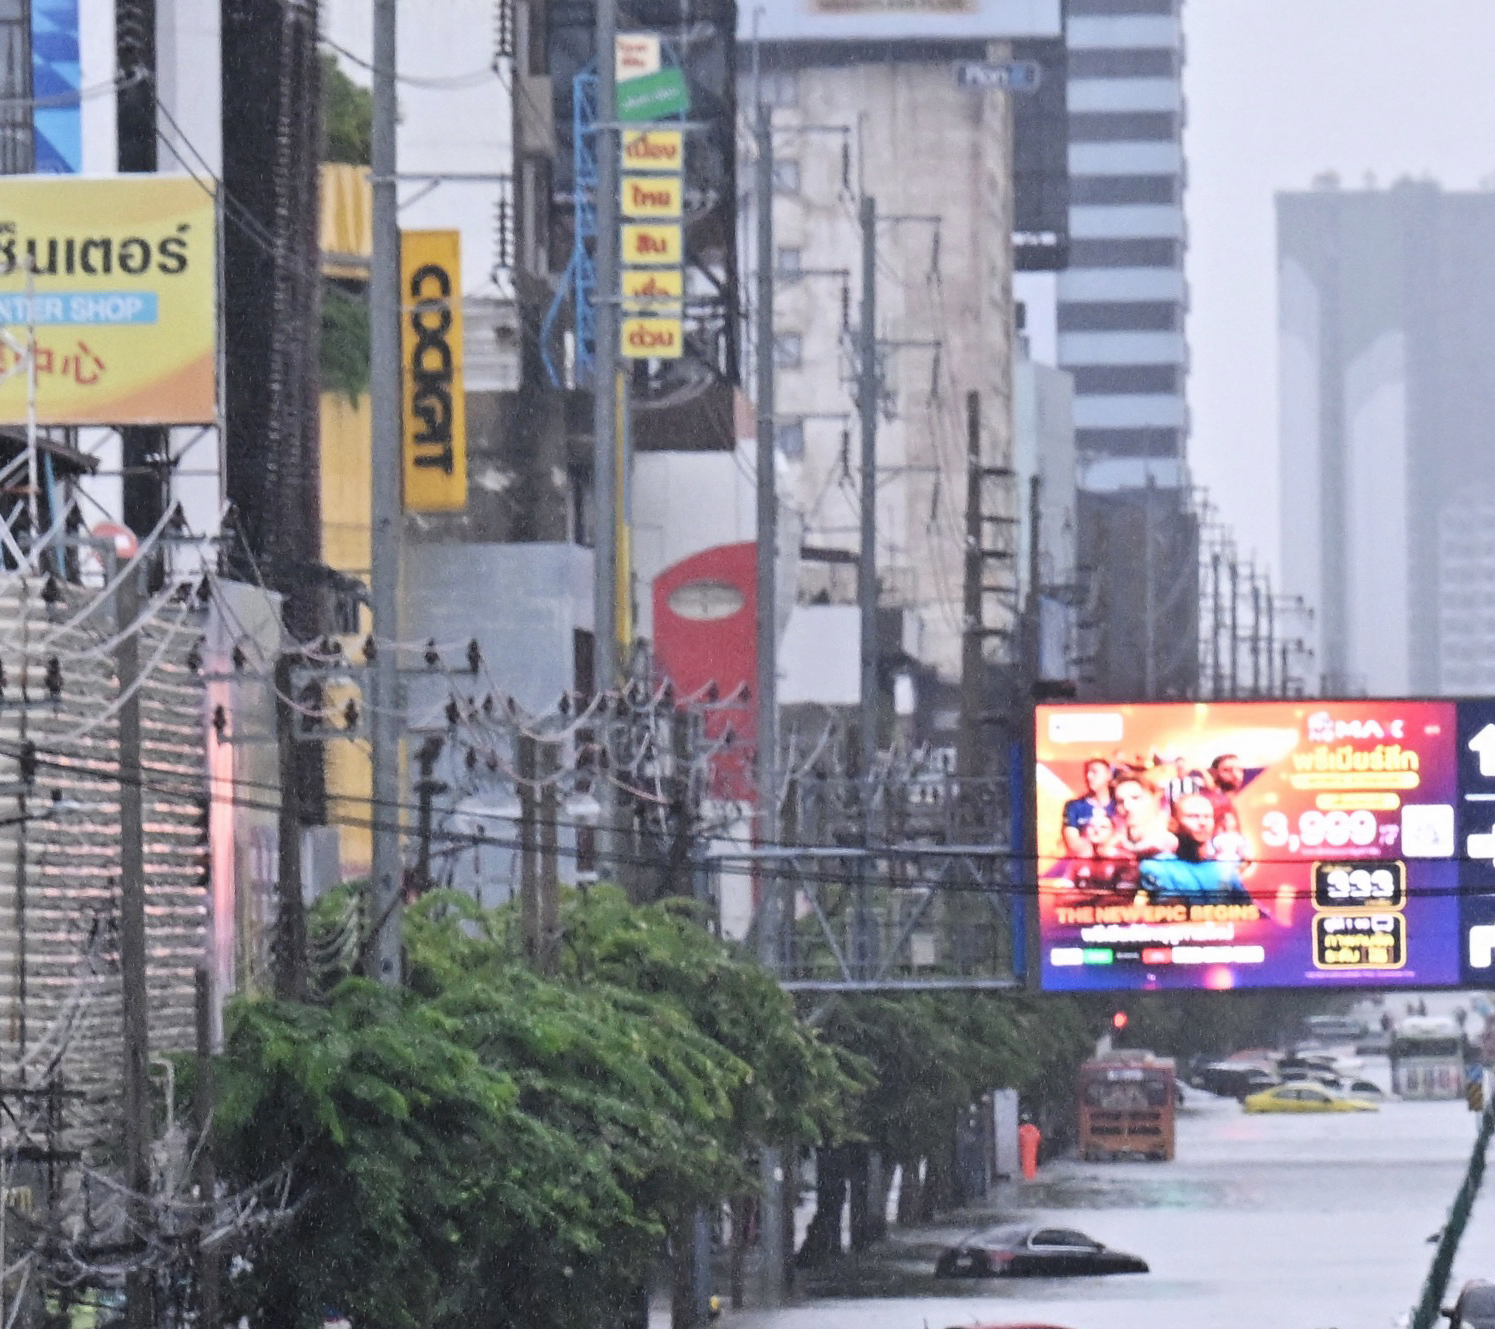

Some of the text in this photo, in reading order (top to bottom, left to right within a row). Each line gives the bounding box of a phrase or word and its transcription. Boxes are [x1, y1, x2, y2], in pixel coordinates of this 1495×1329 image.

[71, 298, 143, 321] SHOP
[410, 263, 454, 476] COCKPIT
[1057, 906, 1094, 924] THE
